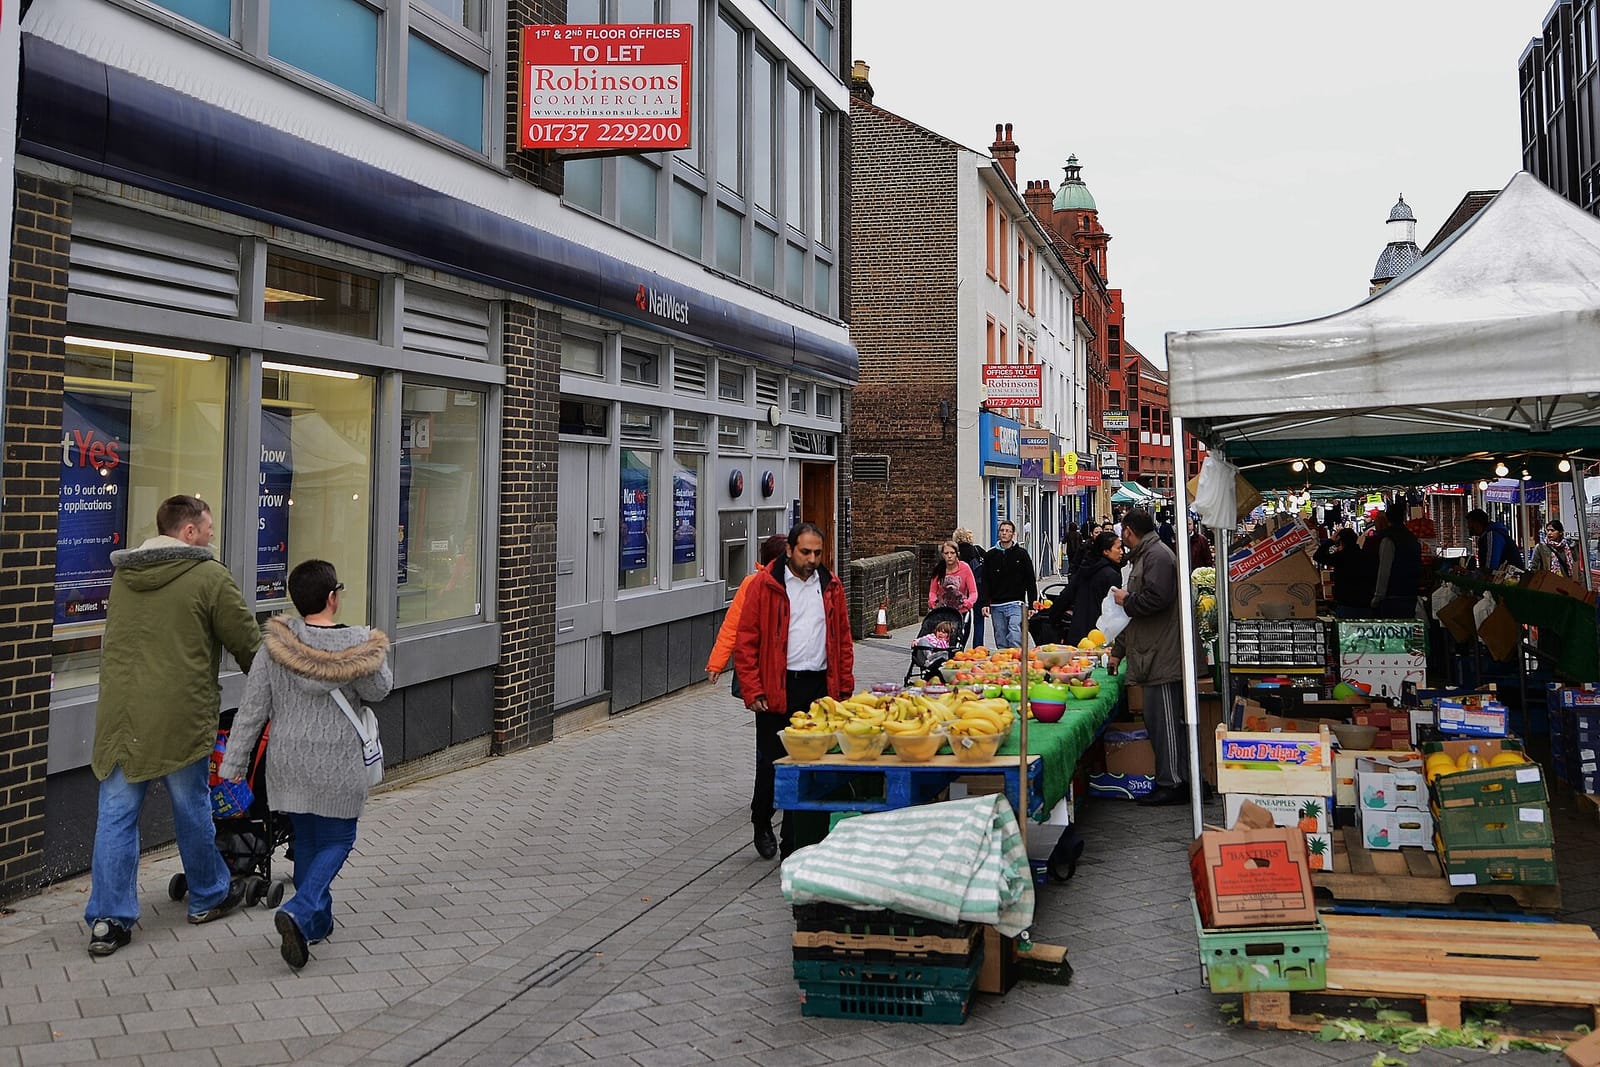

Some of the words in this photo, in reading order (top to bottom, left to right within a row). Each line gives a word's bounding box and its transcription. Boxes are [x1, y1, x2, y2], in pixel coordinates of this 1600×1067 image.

[553, 30, 562, 39] &
[585, 29, 626, 39] FLOOR
[629, 29, 681, 39] OFFICES
[570, 45, 599, 62] TO
[606, 45, 645, 62] LET
[535, 68, 679, 91] Robinsons
[533, 95, 678, 105] COMMERCIAL
[534, 107, 678, 117] www.robinsonsuk.co.uk
[528, 123, 590, 142] 01737
[597, 123, 681, 141] 229200
[649, 287, 689, 325] NatWest
[988, 379, 1038, 388] Robinsons
[260, 444, 286, 463] how
[63, 484, 73, 496] to
[74, 483, 81, 496] 9
[82, 484, 96, 496] out
[97, 483, 106, 496] of
[64, 498, 112, 514] applications
[1228, 743, 1256, 759] Font
[1255, 799, 1296, 807] PINEAPPLES
